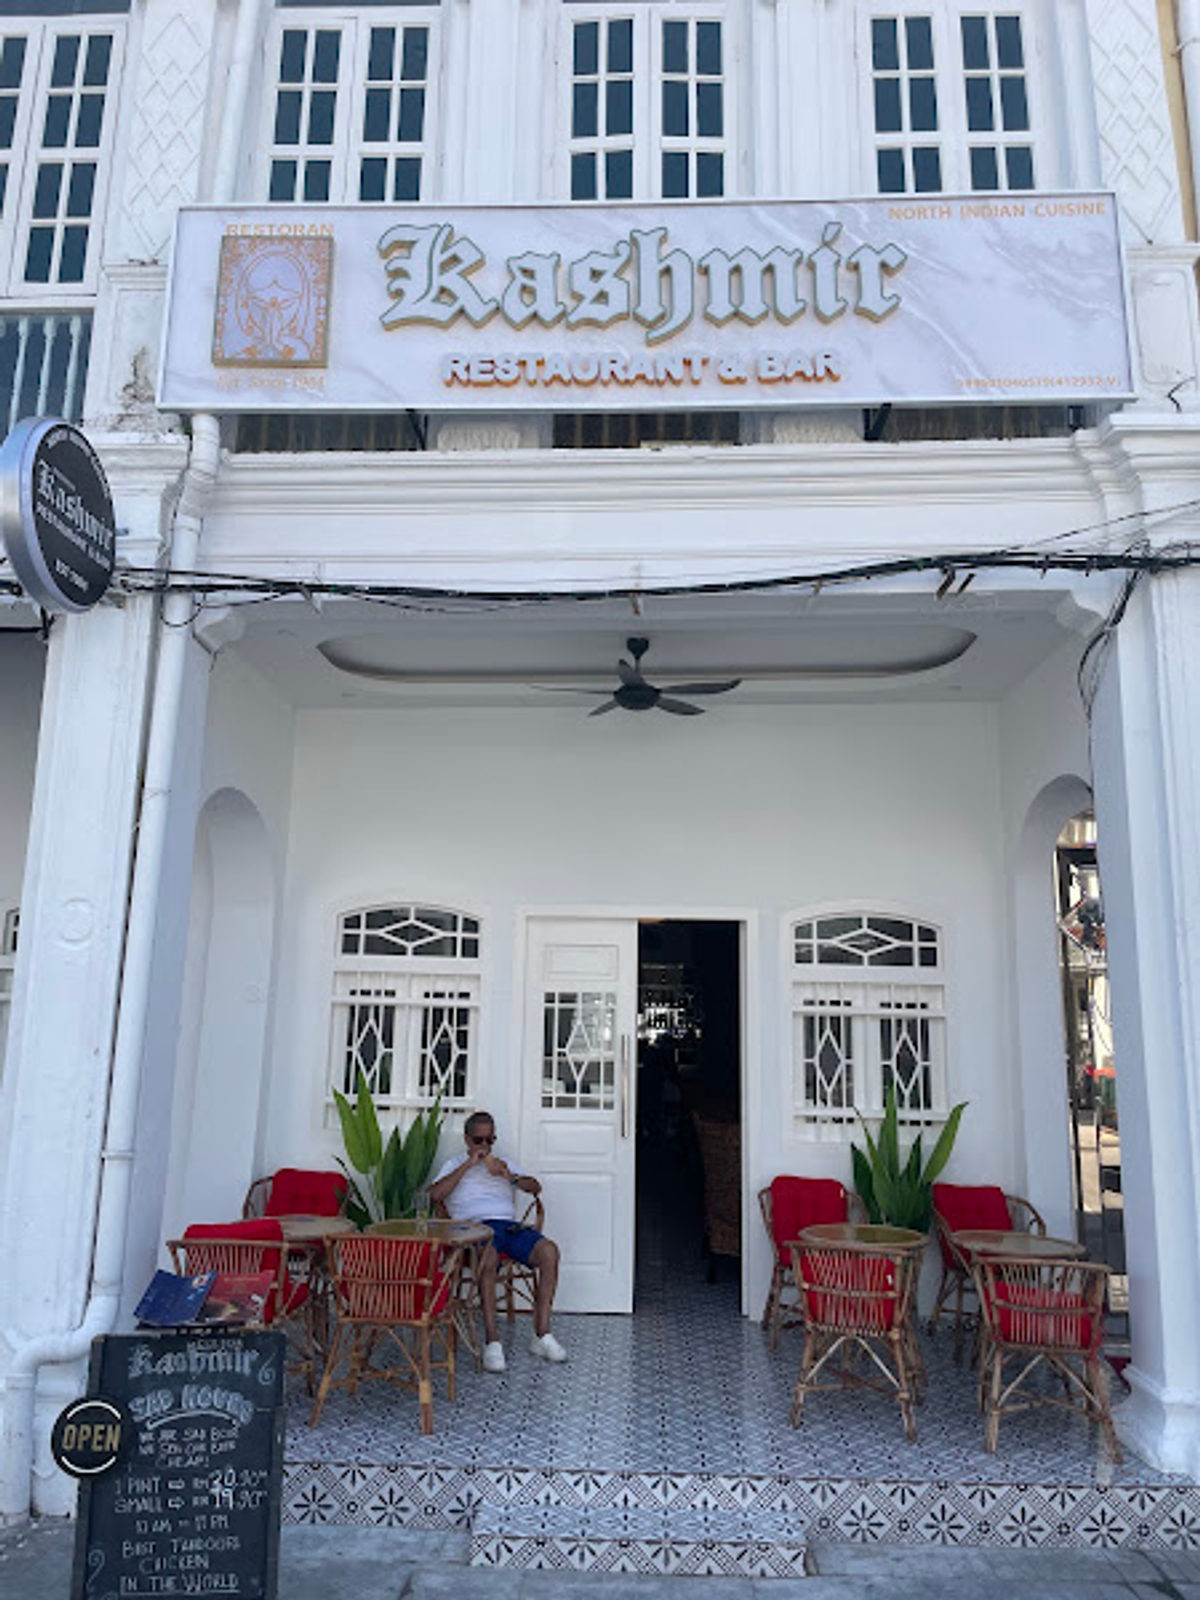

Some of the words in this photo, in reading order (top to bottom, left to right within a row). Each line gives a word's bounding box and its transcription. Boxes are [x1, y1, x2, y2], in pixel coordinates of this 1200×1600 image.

[888, 205, 951, 220] NORTH
[960, 204, 1026, 219] INDIAN
[1034, 202, 1106, 218] CUISINE
[226, 223, 334, 236] RESTORAN
[378, 221, 908, 348] Kashmir
[443, 352, 709, 387] RESTAURANT
[717, 352, 749, 385] &
[757, 350, 842, 384] BAR
[38, 458, 114, 550] Kashmir
[61, 1423, 122, 1452] OPEN
